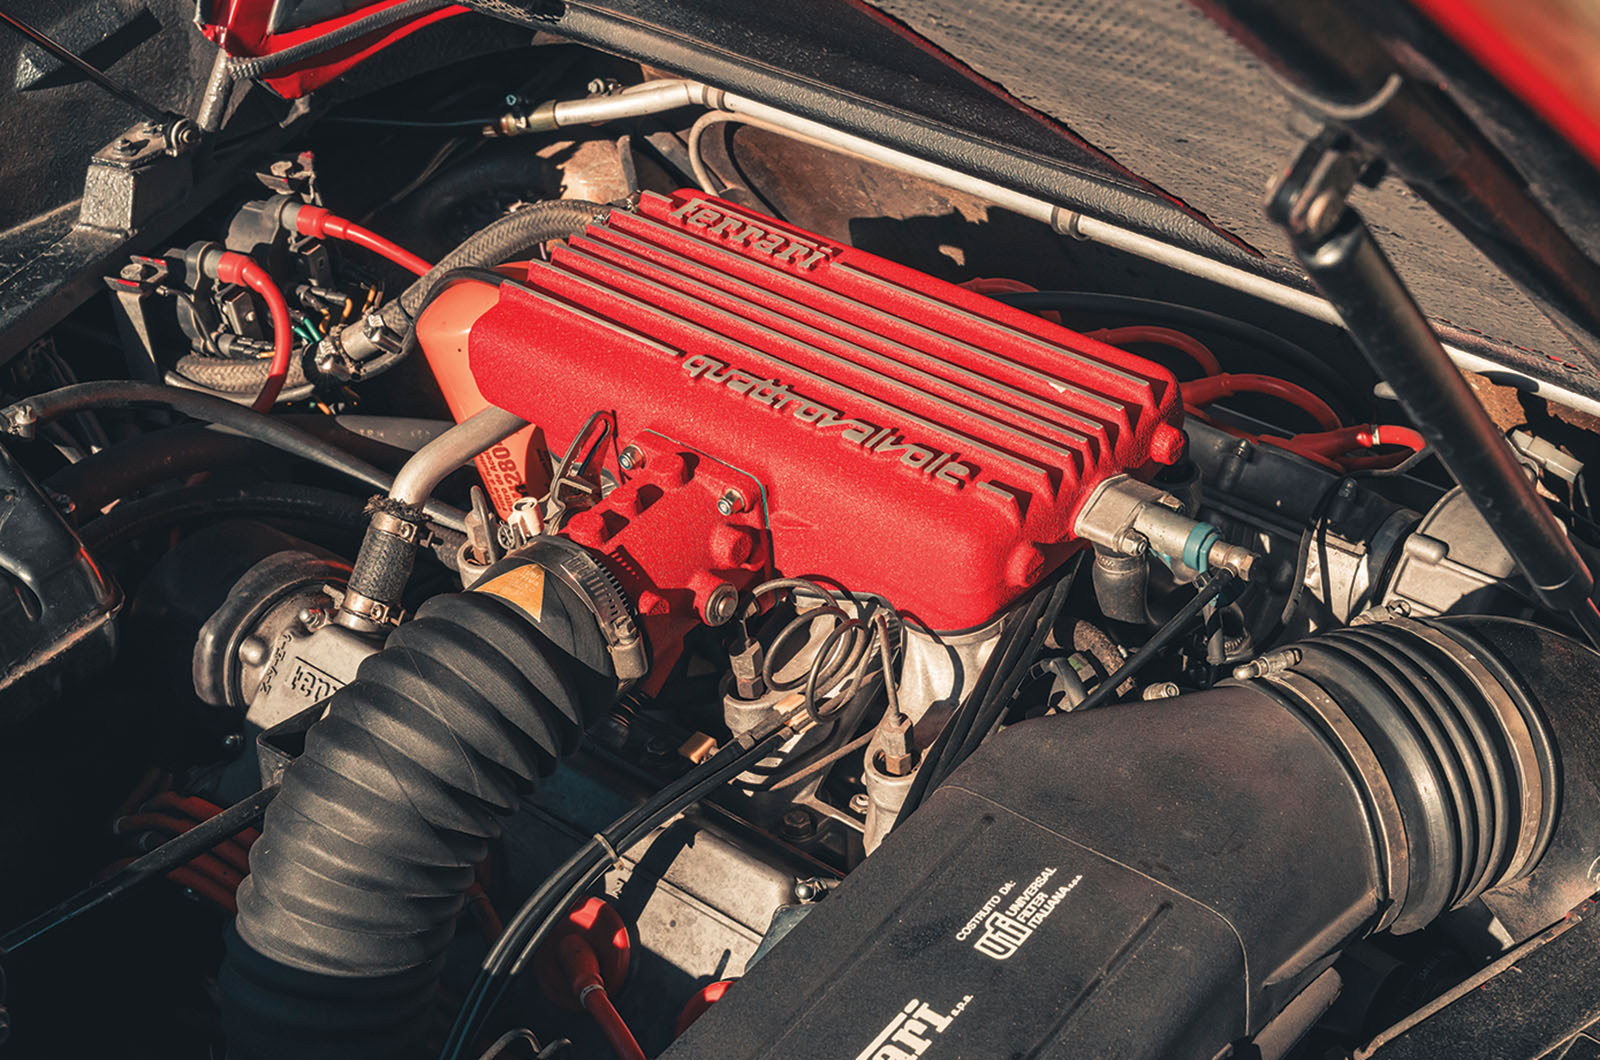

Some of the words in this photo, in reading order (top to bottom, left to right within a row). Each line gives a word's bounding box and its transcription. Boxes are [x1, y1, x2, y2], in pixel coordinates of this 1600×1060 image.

[682, 354, 970, 485] quattrovalvole
[956, 894, 1001, 941] COSTRUITO
[998, 880, 1017, 896] DA:
[1004, 867, 1057, 918] UNIVERSAL
[1015, 891, 1049, 923] FILTER
